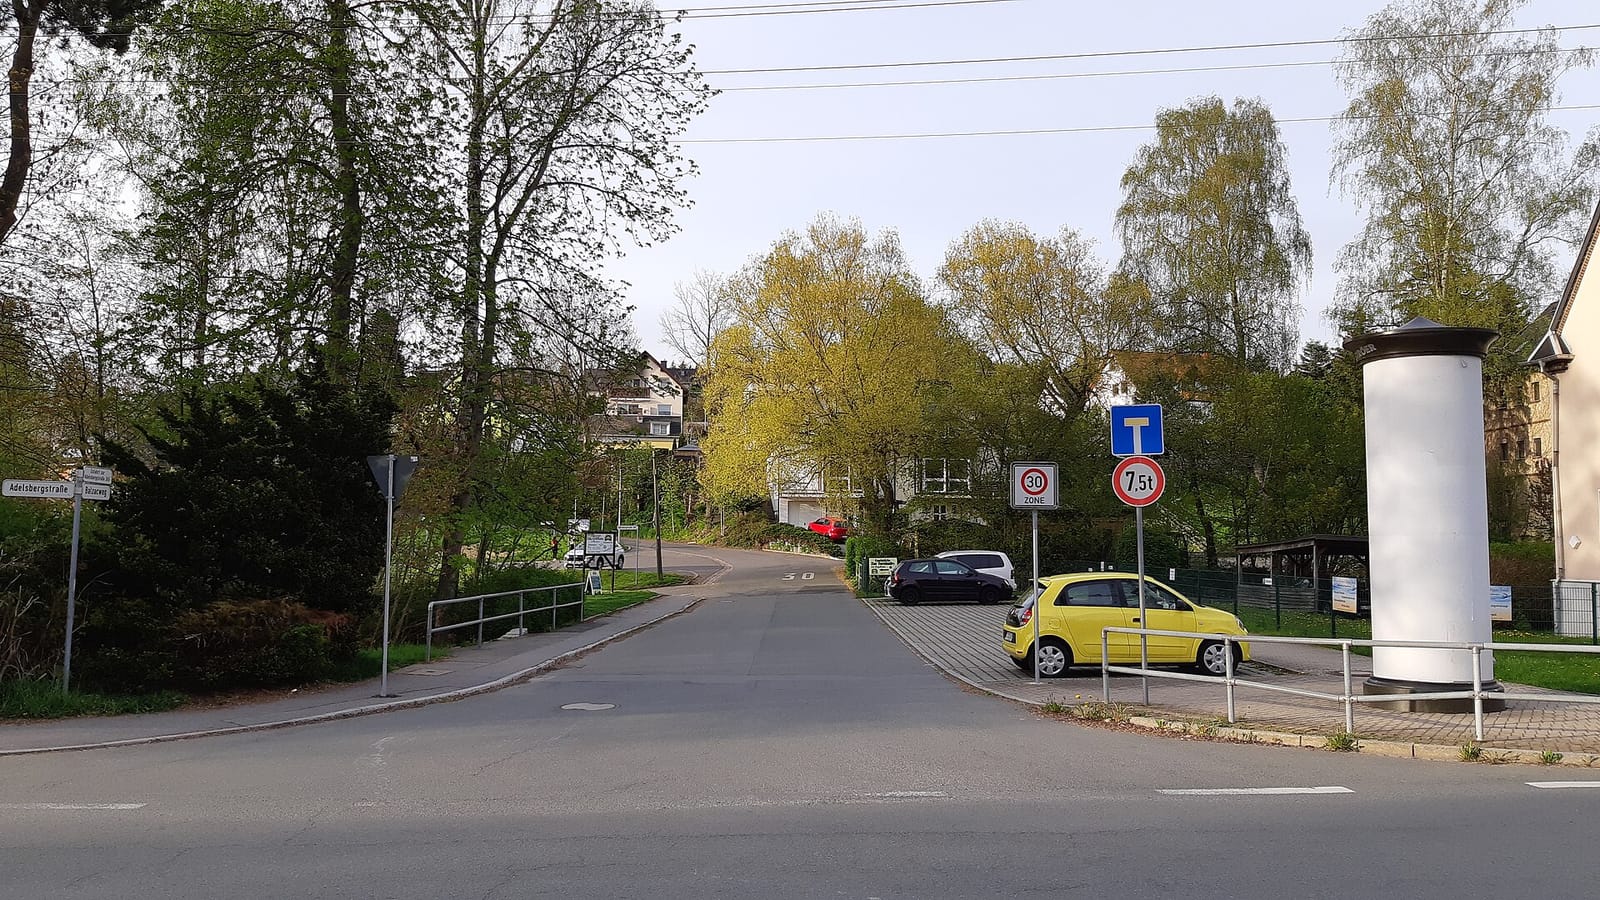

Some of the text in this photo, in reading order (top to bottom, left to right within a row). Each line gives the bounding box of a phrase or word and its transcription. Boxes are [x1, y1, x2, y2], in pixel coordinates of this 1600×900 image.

[9, 483, 69, 494] Adelsbergstraße
[1026, 475, 1043, 489] 30
[1125, 471, 1154, 493] 7,5t
[84, 485, 107, 498] Balzacweg
[781, 572, 816, 581] 30
